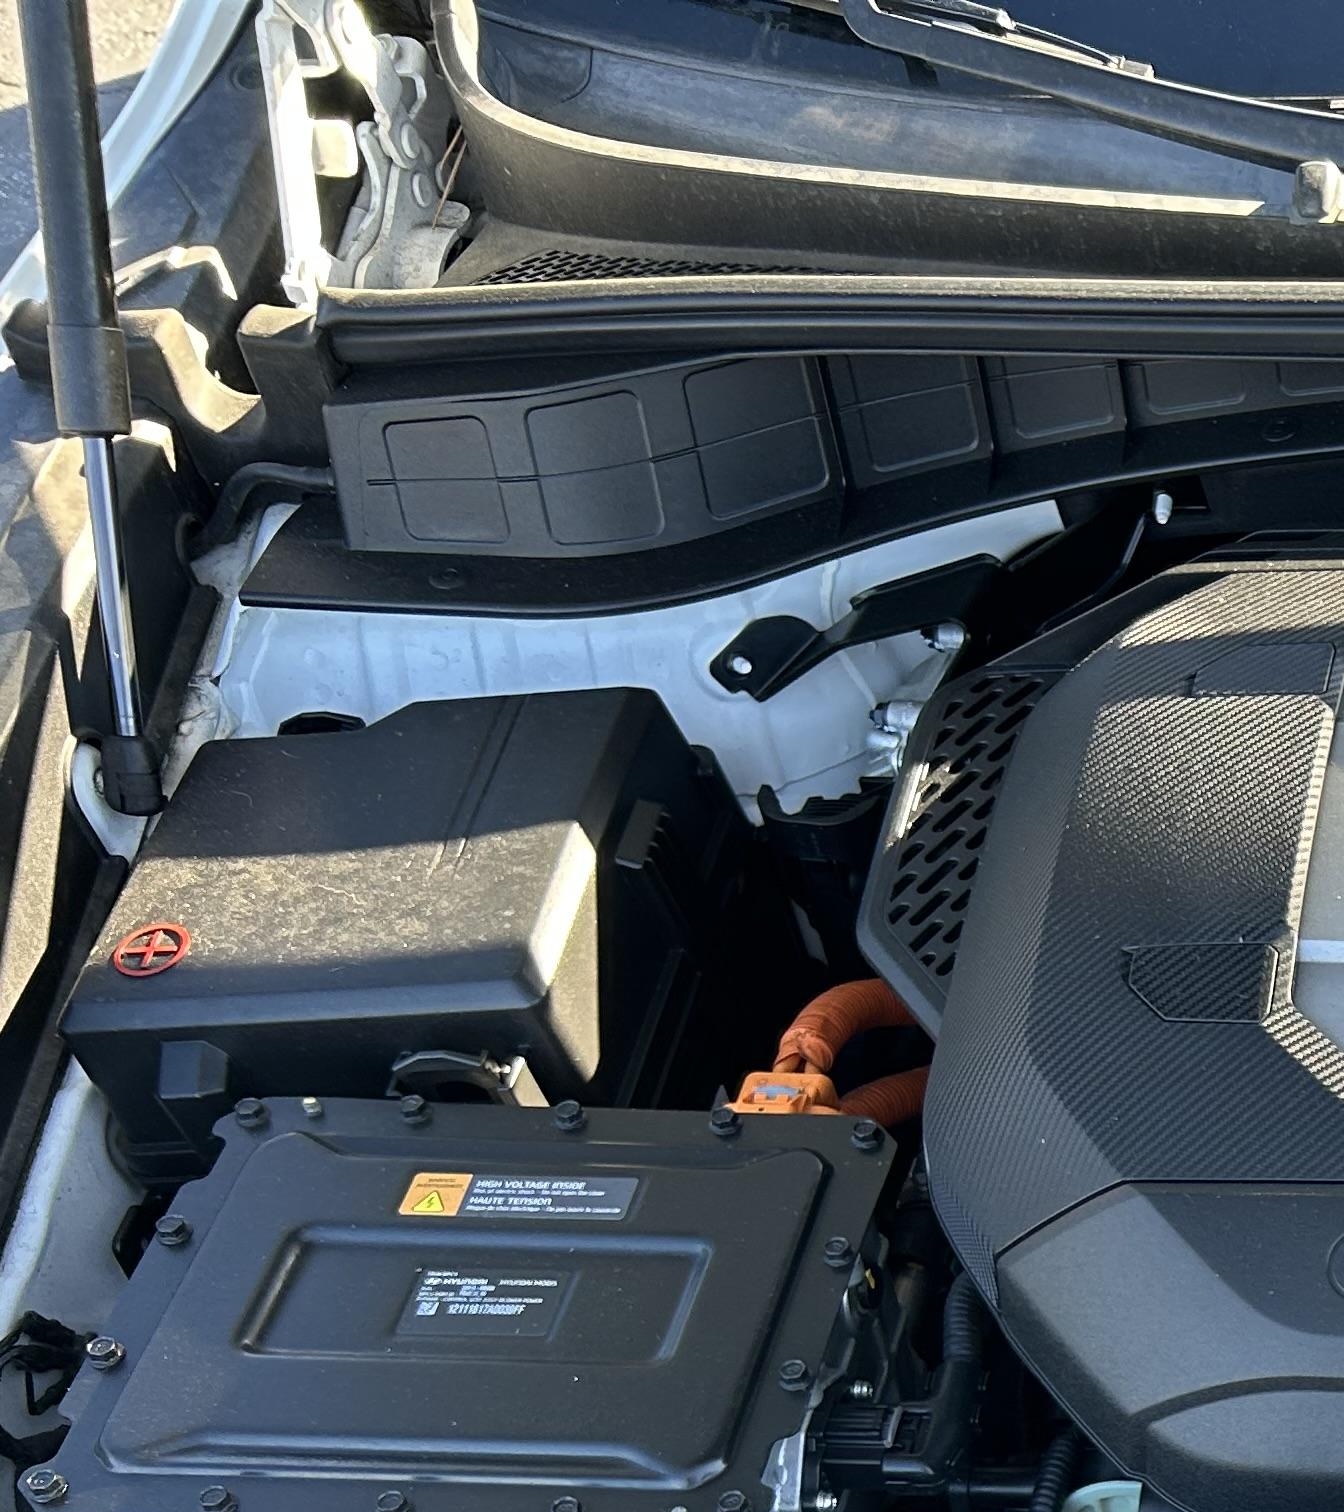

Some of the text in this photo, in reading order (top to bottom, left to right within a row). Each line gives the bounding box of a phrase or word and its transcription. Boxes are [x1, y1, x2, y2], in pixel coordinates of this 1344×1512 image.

[476, 1180, 503, 1189] HIGH
[505, 1181, 550, 1190] VOLTAGE
[470, 1197, 552, 1206] HAUTE TENSION
